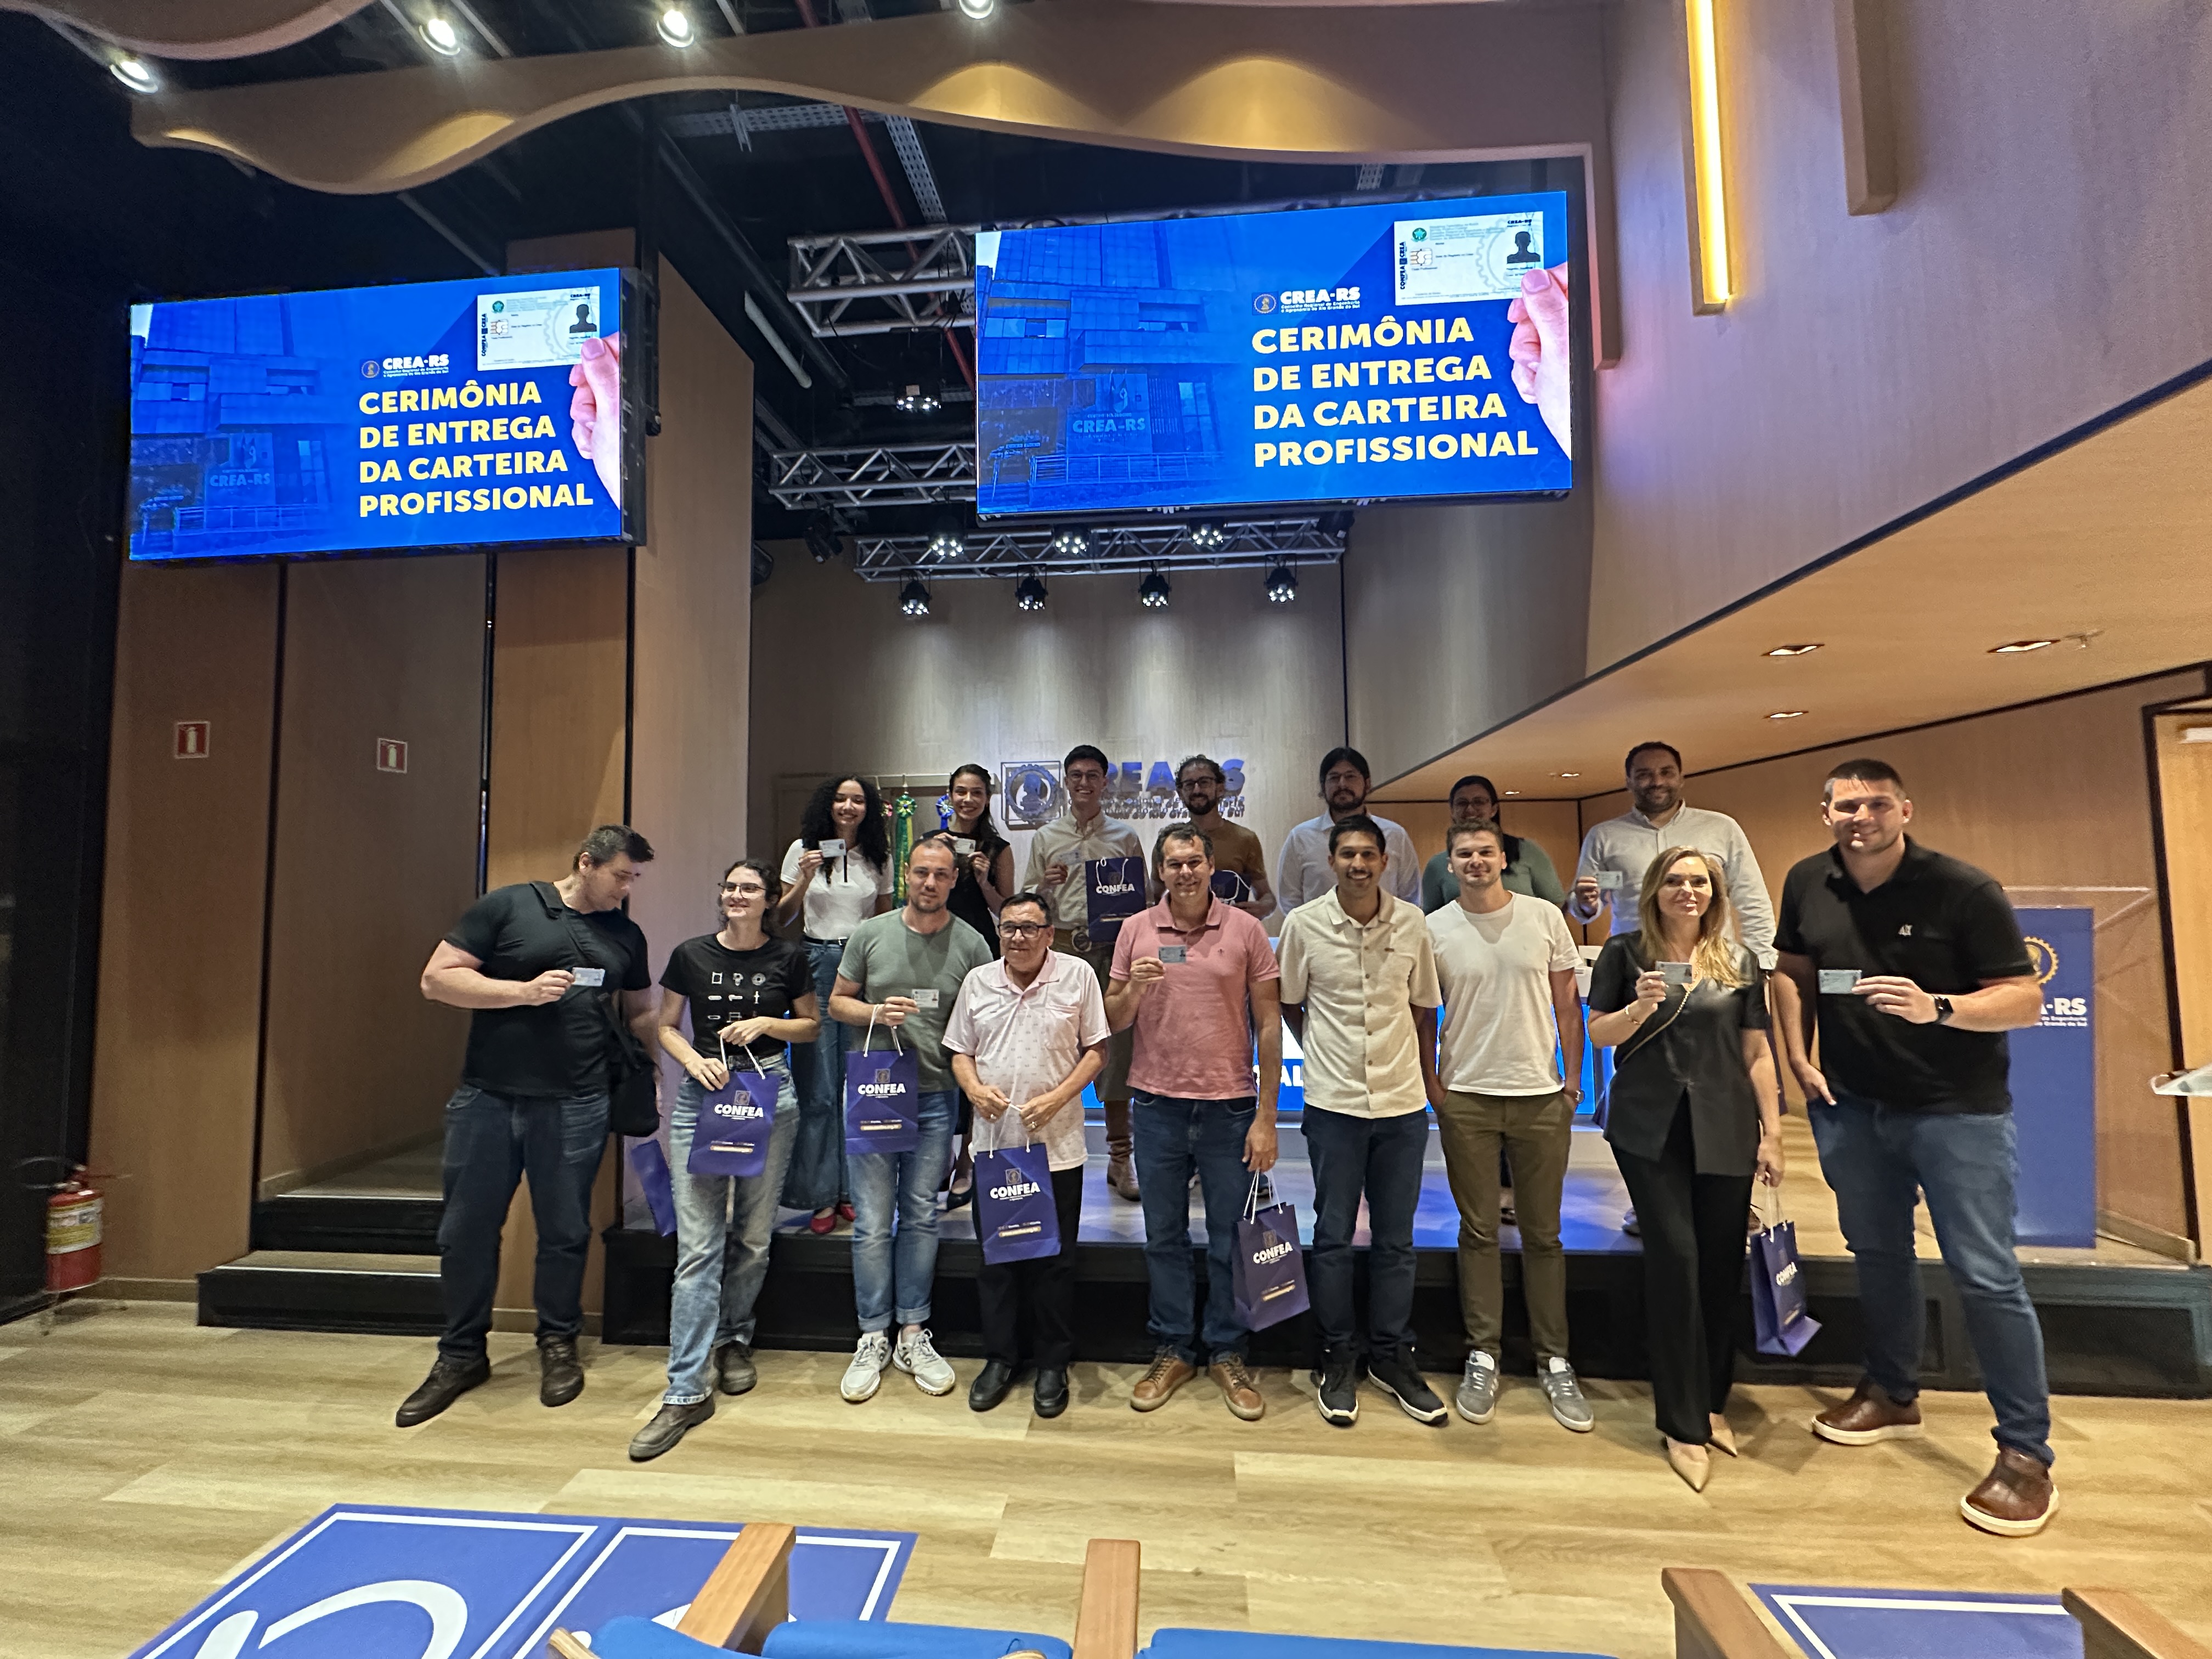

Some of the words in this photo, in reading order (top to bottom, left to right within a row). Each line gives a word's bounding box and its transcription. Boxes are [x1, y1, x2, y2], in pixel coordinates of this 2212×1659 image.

[1280, 286, 1361, 305] CREA-RS
[1252, 315, 1473, 354] CERIMÔNIA
[382, 354, 449, 370] CREA-RS
[1253, 366, 1300, 391] DE
[1312, 355, 1491, 388] ENTREGA
[360, 380, 541, 414] CERIMÔNIA
[1073, 417, 1146, 433] CREA-RS
[1254, 404, 1304, 430] DA
[1314, 393, 1506, 425] CARTEIRA
[360, 426, 398, 448] DE
[408, 415, 555, 444] ENTREGA
[1254, 431, 1538, 467] PROFISSIONAL
[360, 461, 401, 483] DA
[409, 450, 567, 479] CARTEIRA
[360, 484, 594, 516] PROFISSIONAL
[1096, 883, 1135, 894] CONFEA
[857, 1083, 906, 1095] CONFEA
[714, 1103, 764, 1118] CONFEA
[990, 1182, 1041, 1199] CONFEA
[1252, 1242, 1293, 1264] CONFEA
